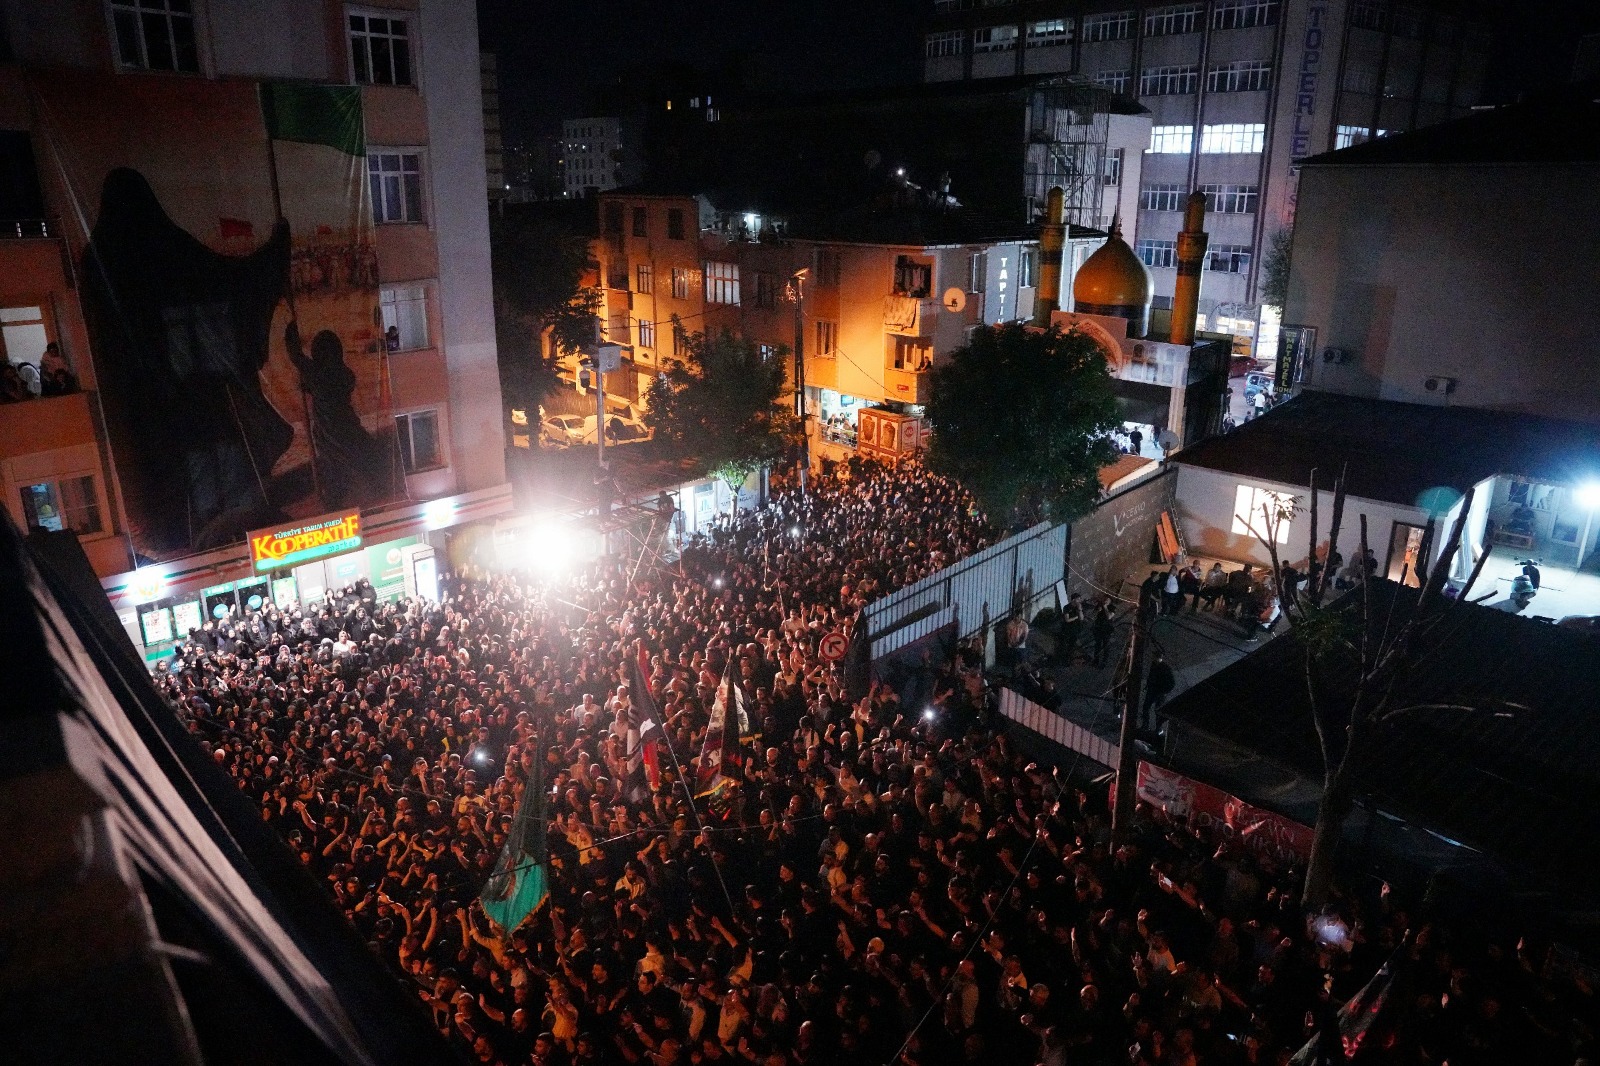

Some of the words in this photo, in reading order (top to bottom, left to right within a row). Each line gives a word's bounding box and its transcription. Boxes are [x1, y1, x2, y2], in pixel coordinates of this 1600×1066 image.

[1281, 338, 1294, 387] MATMAZEL
[303, 523, 323, 534] TARIM
[328, 539, 357, 553] market
